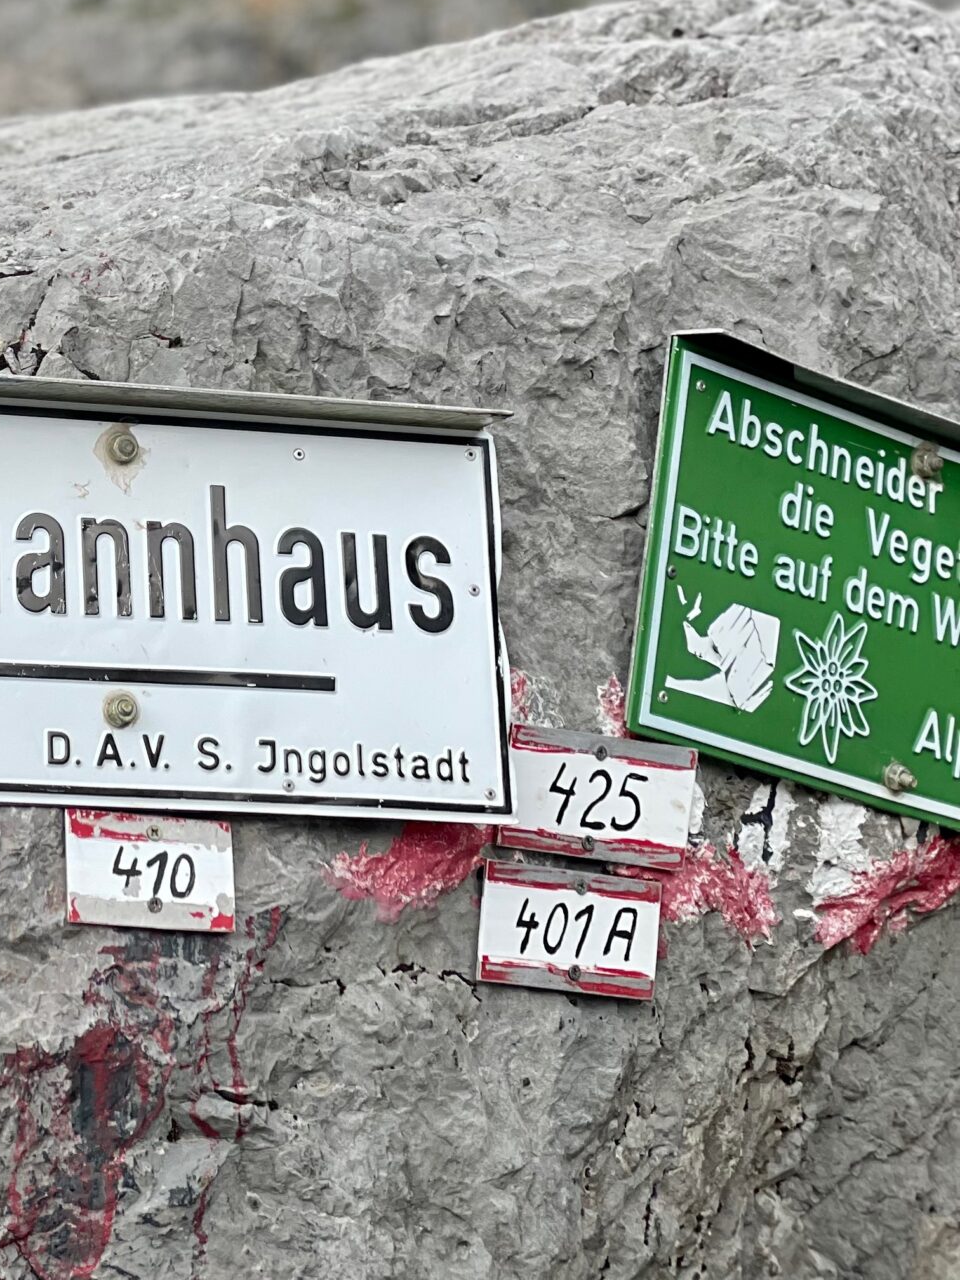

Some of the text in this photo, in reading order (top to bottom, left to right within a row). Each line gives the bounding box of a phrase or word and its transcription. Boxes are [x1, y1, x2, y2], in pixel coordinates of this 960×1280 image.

[707, 390, 943, 514] Abschneider
[780, 481, 960, 584] die Vege
[673, 504, 759, 577] Bitte
[775, 554, 833, 602] auf
[844, 566, 919, 633] dem
[197, 736, 233, 771] S.
[913, 708, 960, 779] Al
[548, 762, 649, 832] 425
[111, 845, 197, 899] 410
